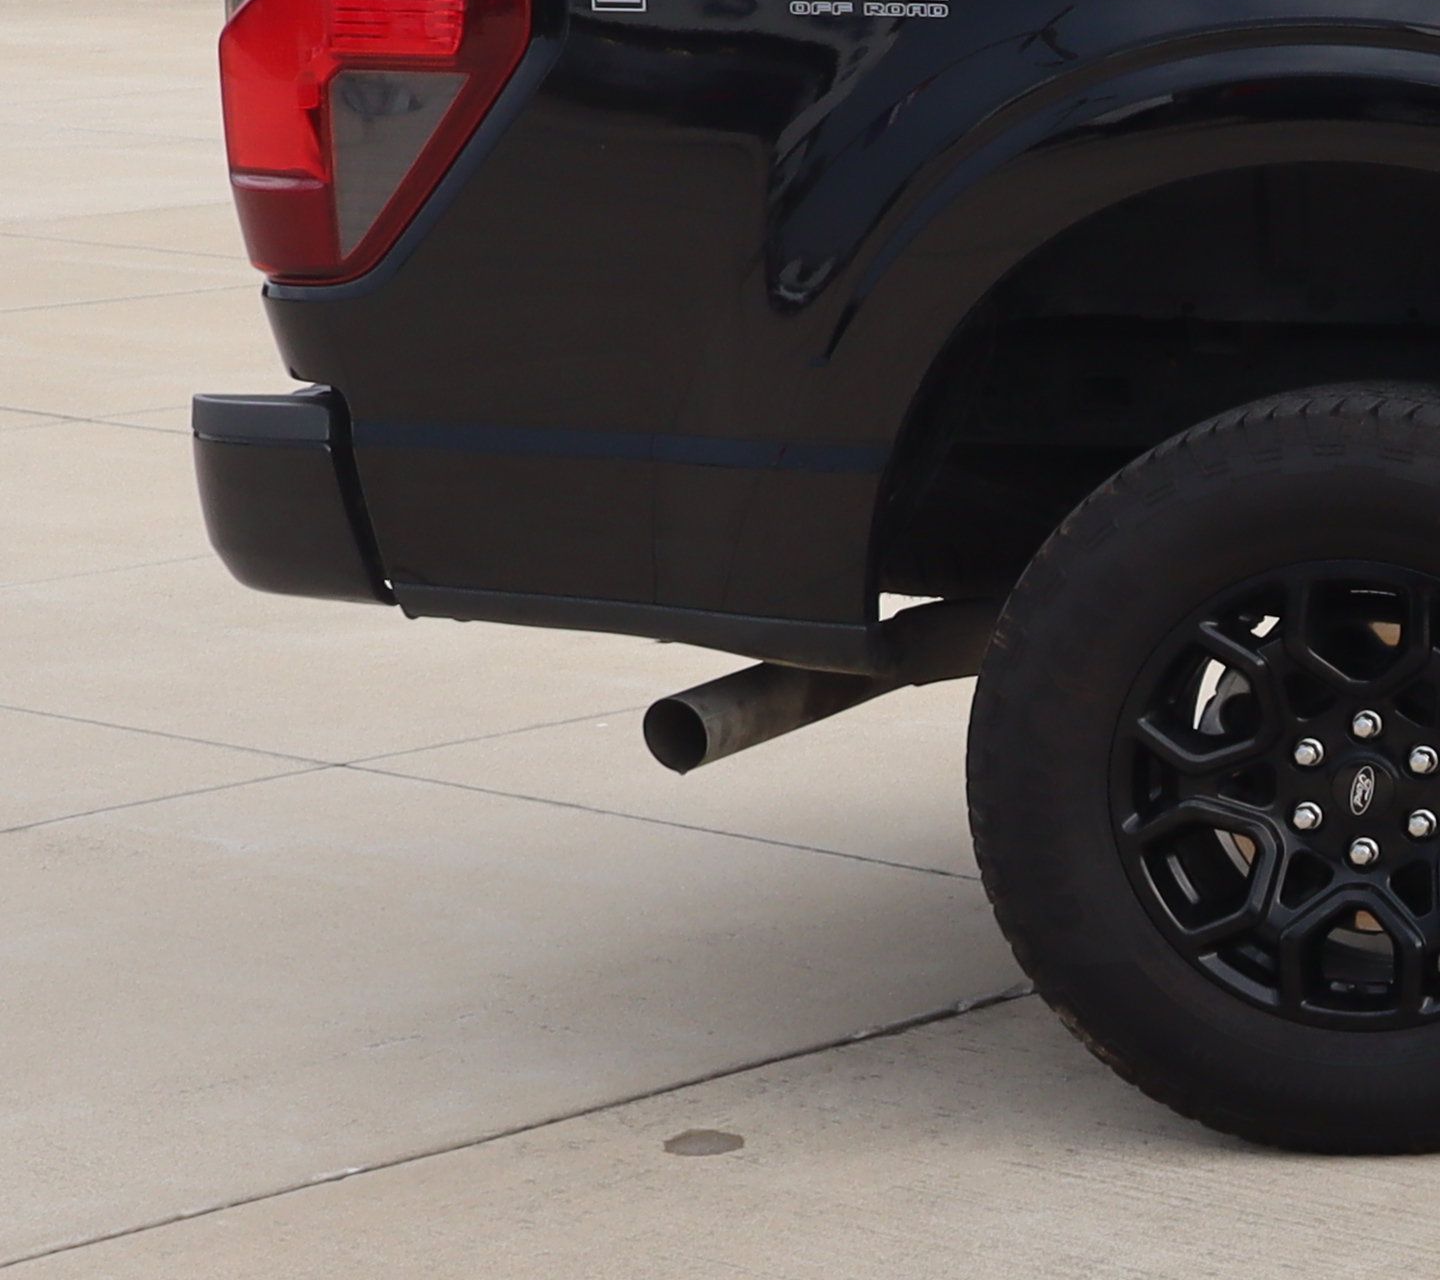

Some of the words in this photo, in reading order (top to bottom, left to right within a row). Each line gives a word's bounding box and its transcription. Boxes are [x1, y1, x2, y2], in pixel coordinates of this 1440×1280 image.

[789, 1, 853, 16] OFF
[863, 2, 950, 18] ROAD
[1352, 772, 1373, 809] Ford
